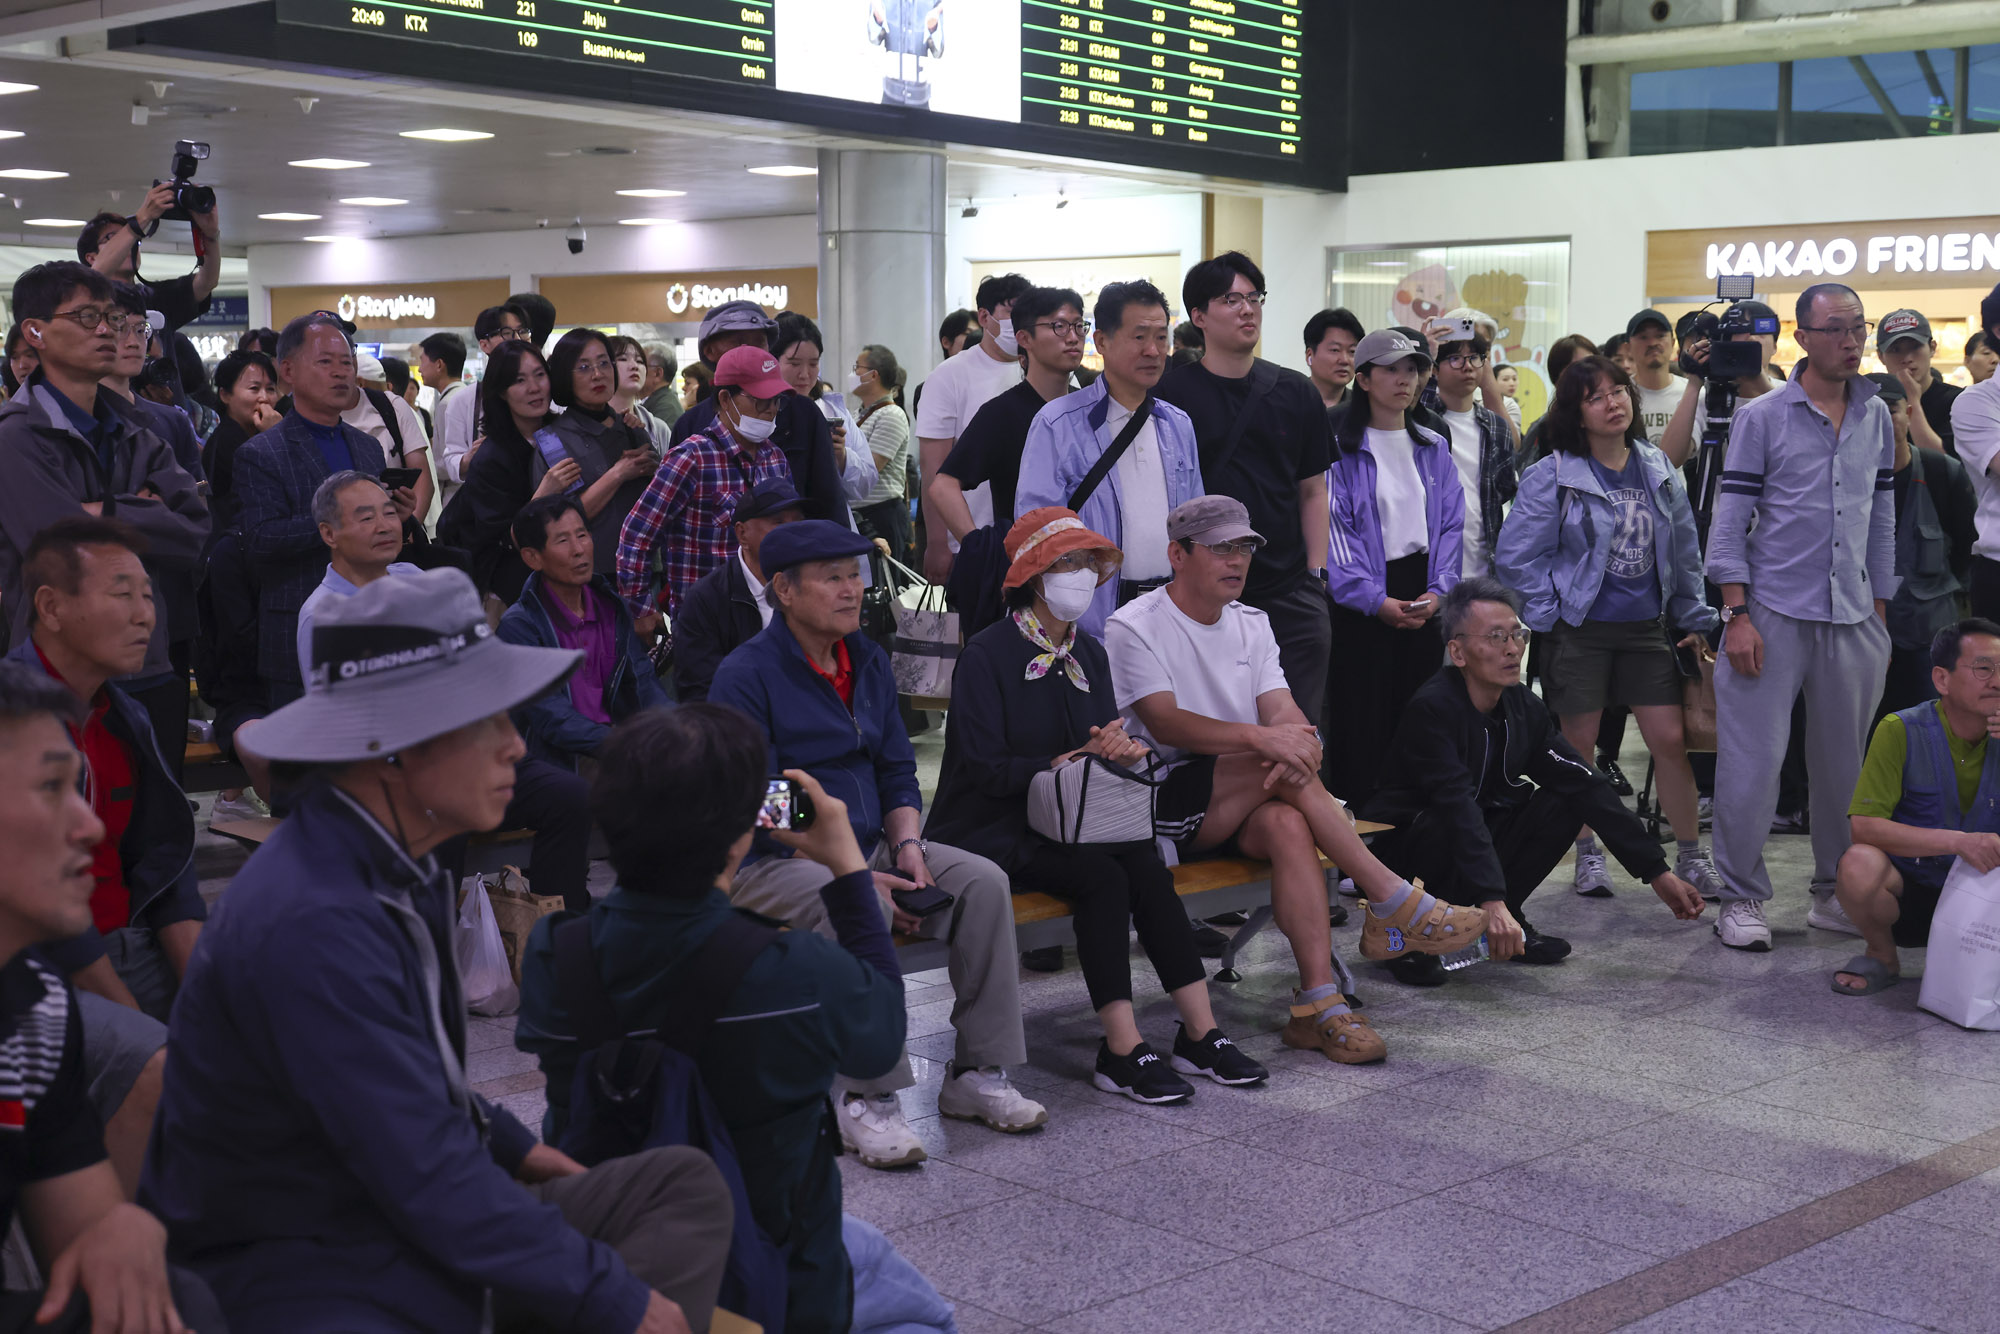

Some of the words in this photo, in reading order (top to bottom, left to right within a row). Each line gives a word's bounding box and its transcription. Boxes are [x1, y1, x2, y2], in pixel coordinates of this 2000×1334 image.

[517, 1, 536, 17] 221
[582, 10, 607, 30] Jinju
[352, 7, 385, 26] 20:49
[404, 14, 428, 32] KTX
[518, 31, 538, 47] 109
[583, 40, 614, 58] Busan
[1705, 237, 1857, 280] KAKAO
[1866, 232, 2000, 274] FRIEN
[1616, 490, 1647, 503] VOLTA
[1624, 547, 1644, 559] 1975
[1606, 557, 1626, 574] OCK
